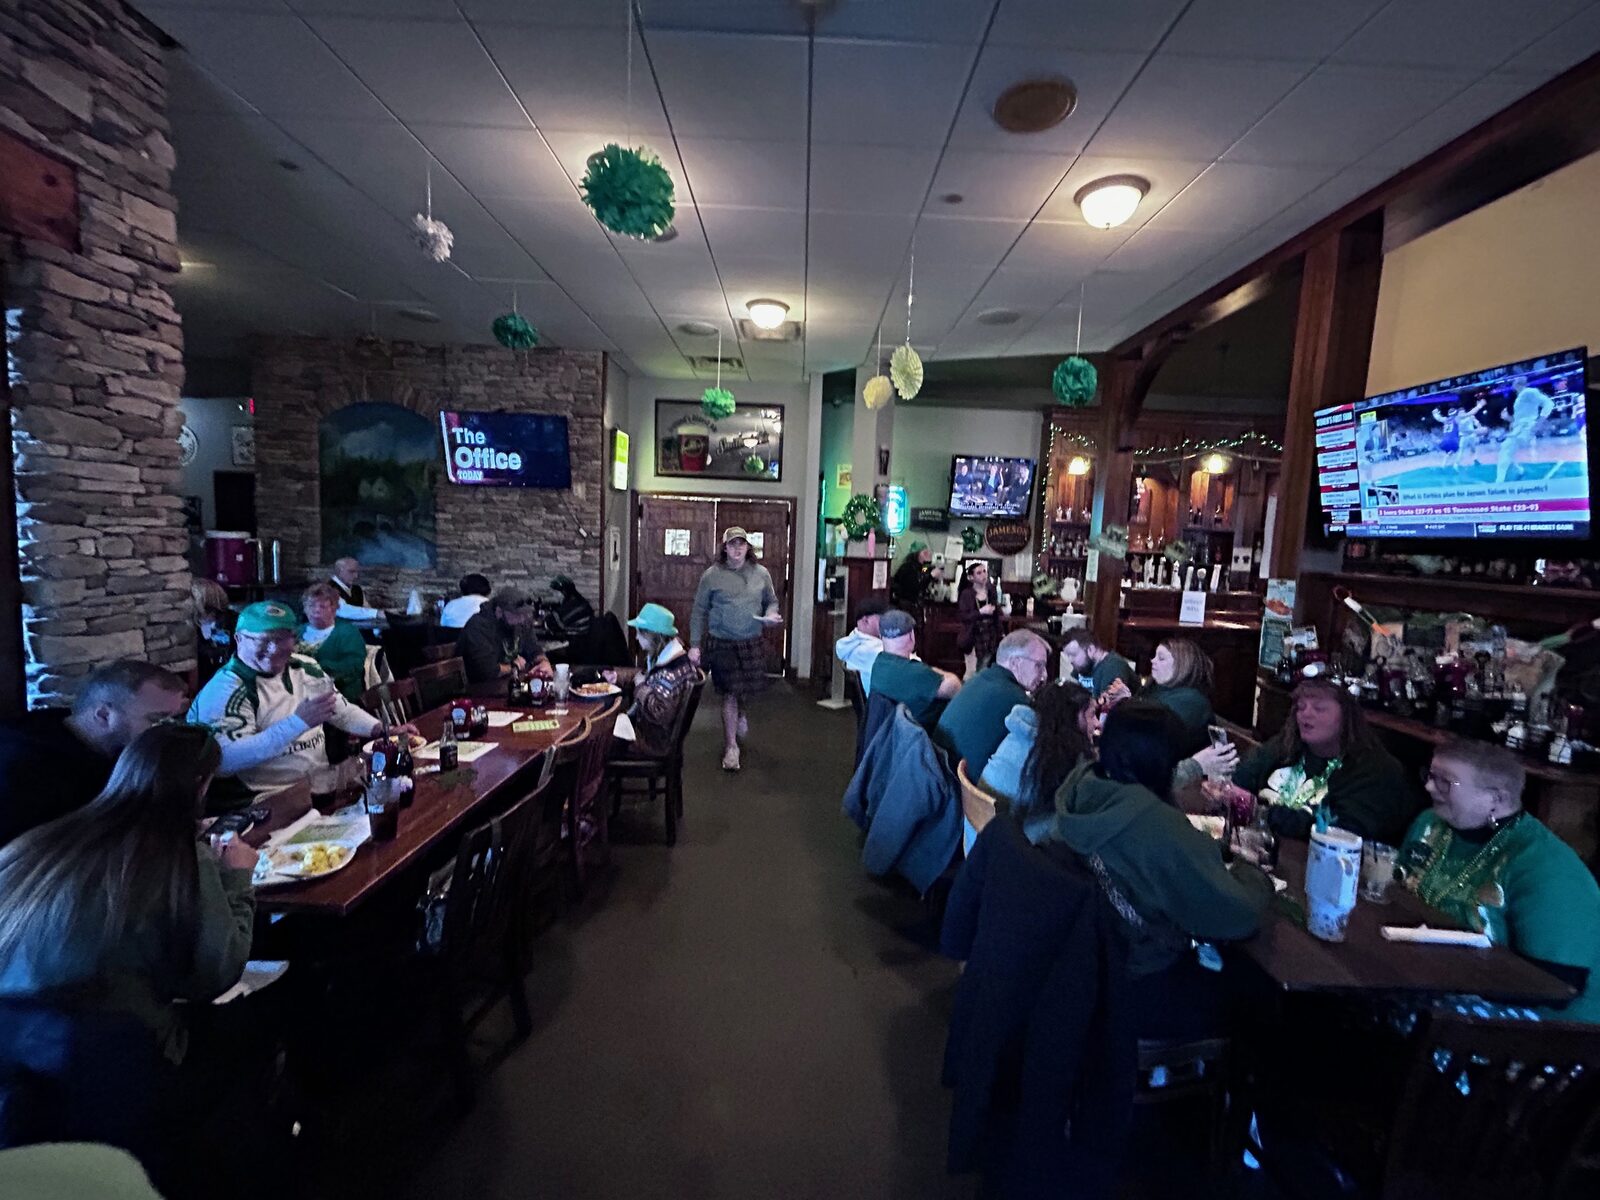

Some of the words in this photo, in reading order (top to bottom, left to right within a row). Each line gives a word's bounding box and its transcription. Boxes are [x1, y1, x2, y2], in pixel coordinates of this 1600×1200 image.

[452, 427, 486, 444] The
[454, 446, 522, 470] Office
[457, 469, 484, 481] TODAY
[989, 524, 1028, 537] JAMESON
